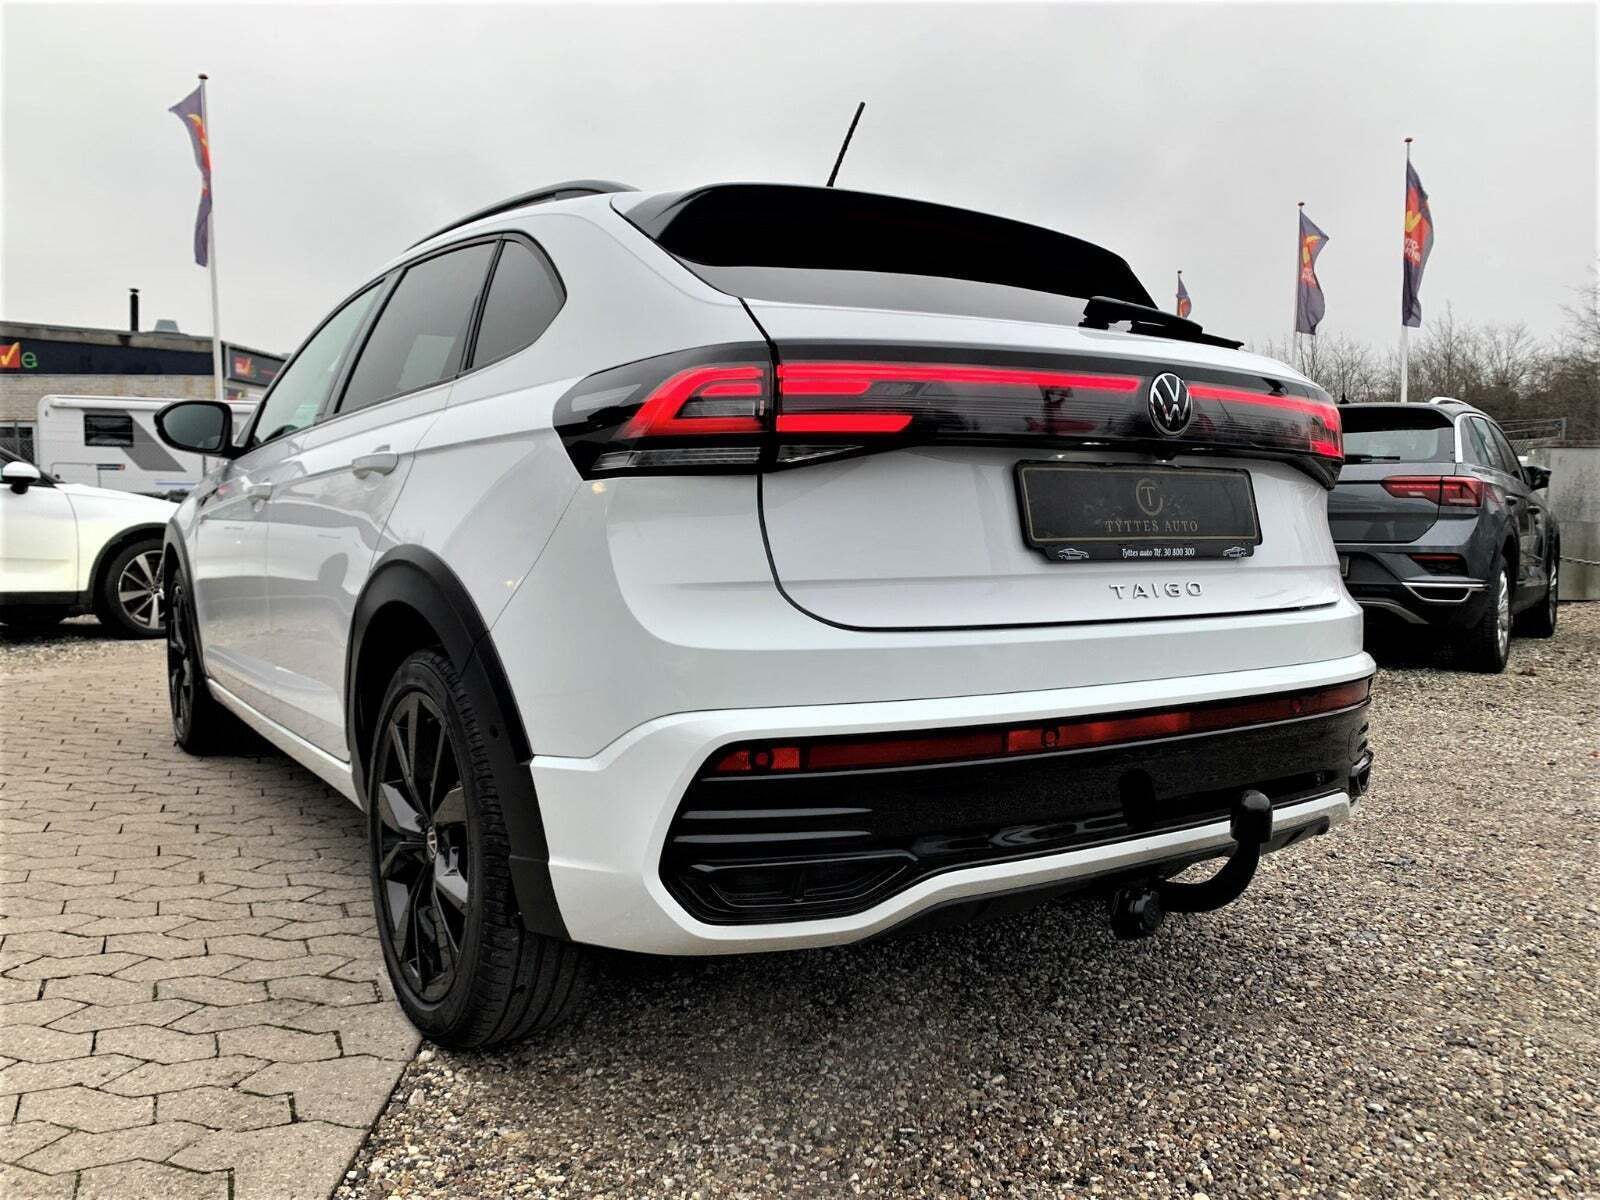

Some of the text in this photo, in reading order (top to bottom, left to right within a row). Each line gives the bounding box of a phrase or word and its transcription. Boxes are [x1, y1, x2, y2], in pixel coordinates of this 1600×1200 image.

[1105, 519, 1199, 533] TYTTES AUTO
[1121, 548, 1138, 559] Tyttes
[1139, 549, 1153, 557] auto
[1163, 547, 1172, 556] 30
[1184, 547, 1195, 556] 300
[1108, 582, 1202, 600] TAIGO
